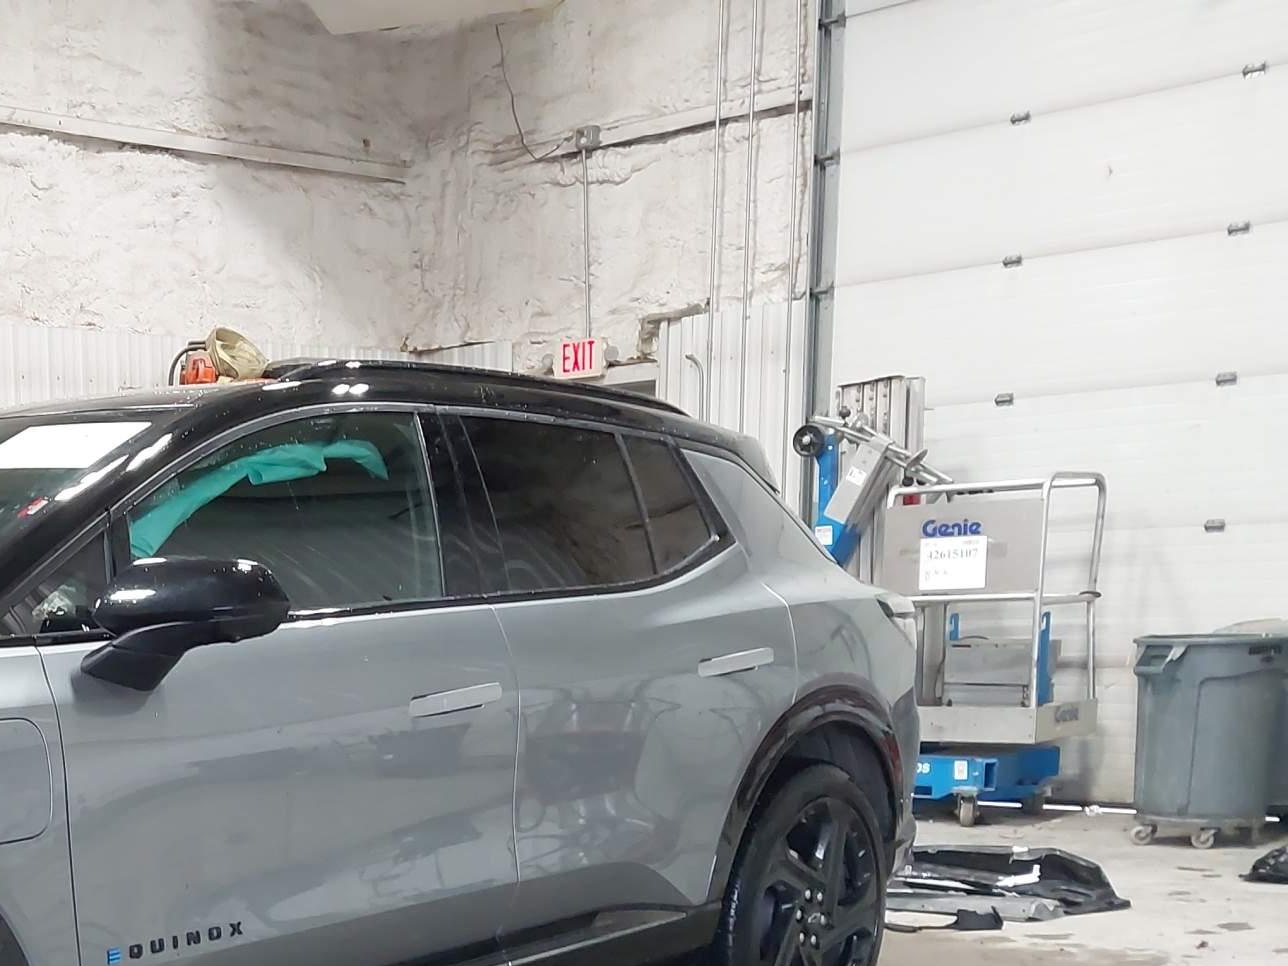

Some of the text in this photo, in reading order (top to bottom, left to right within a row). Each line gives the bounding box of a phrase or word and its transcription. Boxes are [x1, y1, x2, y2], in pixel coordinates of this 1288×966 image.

[562, 340, 595, 373] EXIT
[921, 518, 982, 538] Genie
[106, 921, 244, 966] EQUINOX
